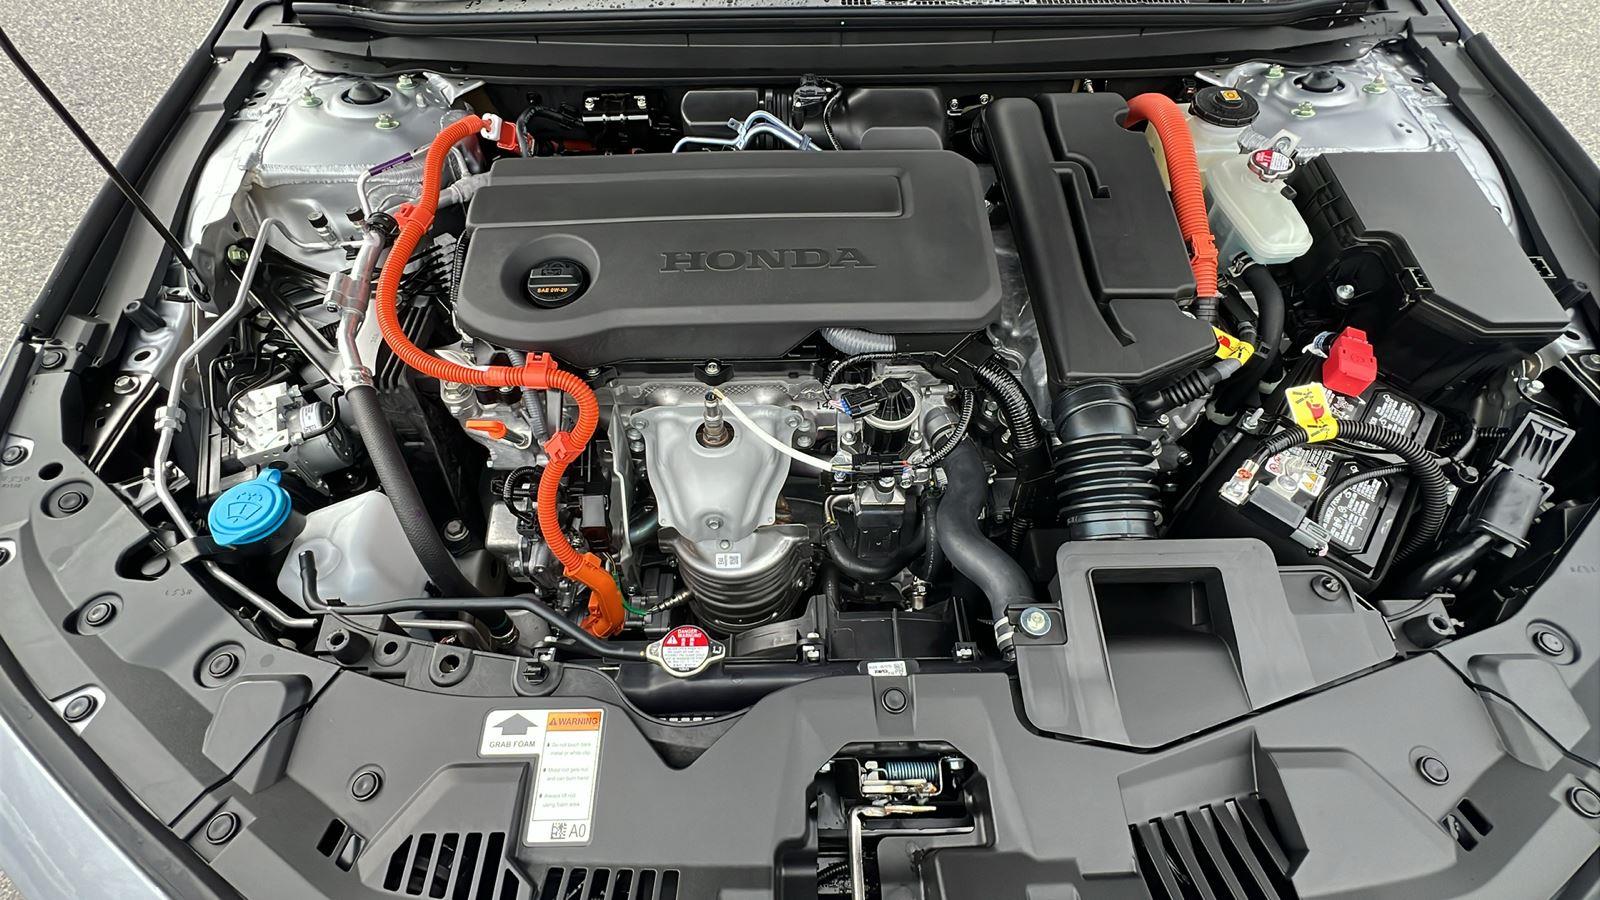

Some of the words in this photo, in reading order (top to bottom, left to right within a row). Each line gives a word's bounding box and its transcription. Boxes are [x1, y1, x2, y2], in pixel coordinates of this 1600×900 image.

[658, 248, 877, 273] HONDA
[559, 717, 598, 725] WARNING
[489, 740, 512, 748] GRAB
[513, 740, 536, 748] FOAM
[568, 823, 587, 838] A0
